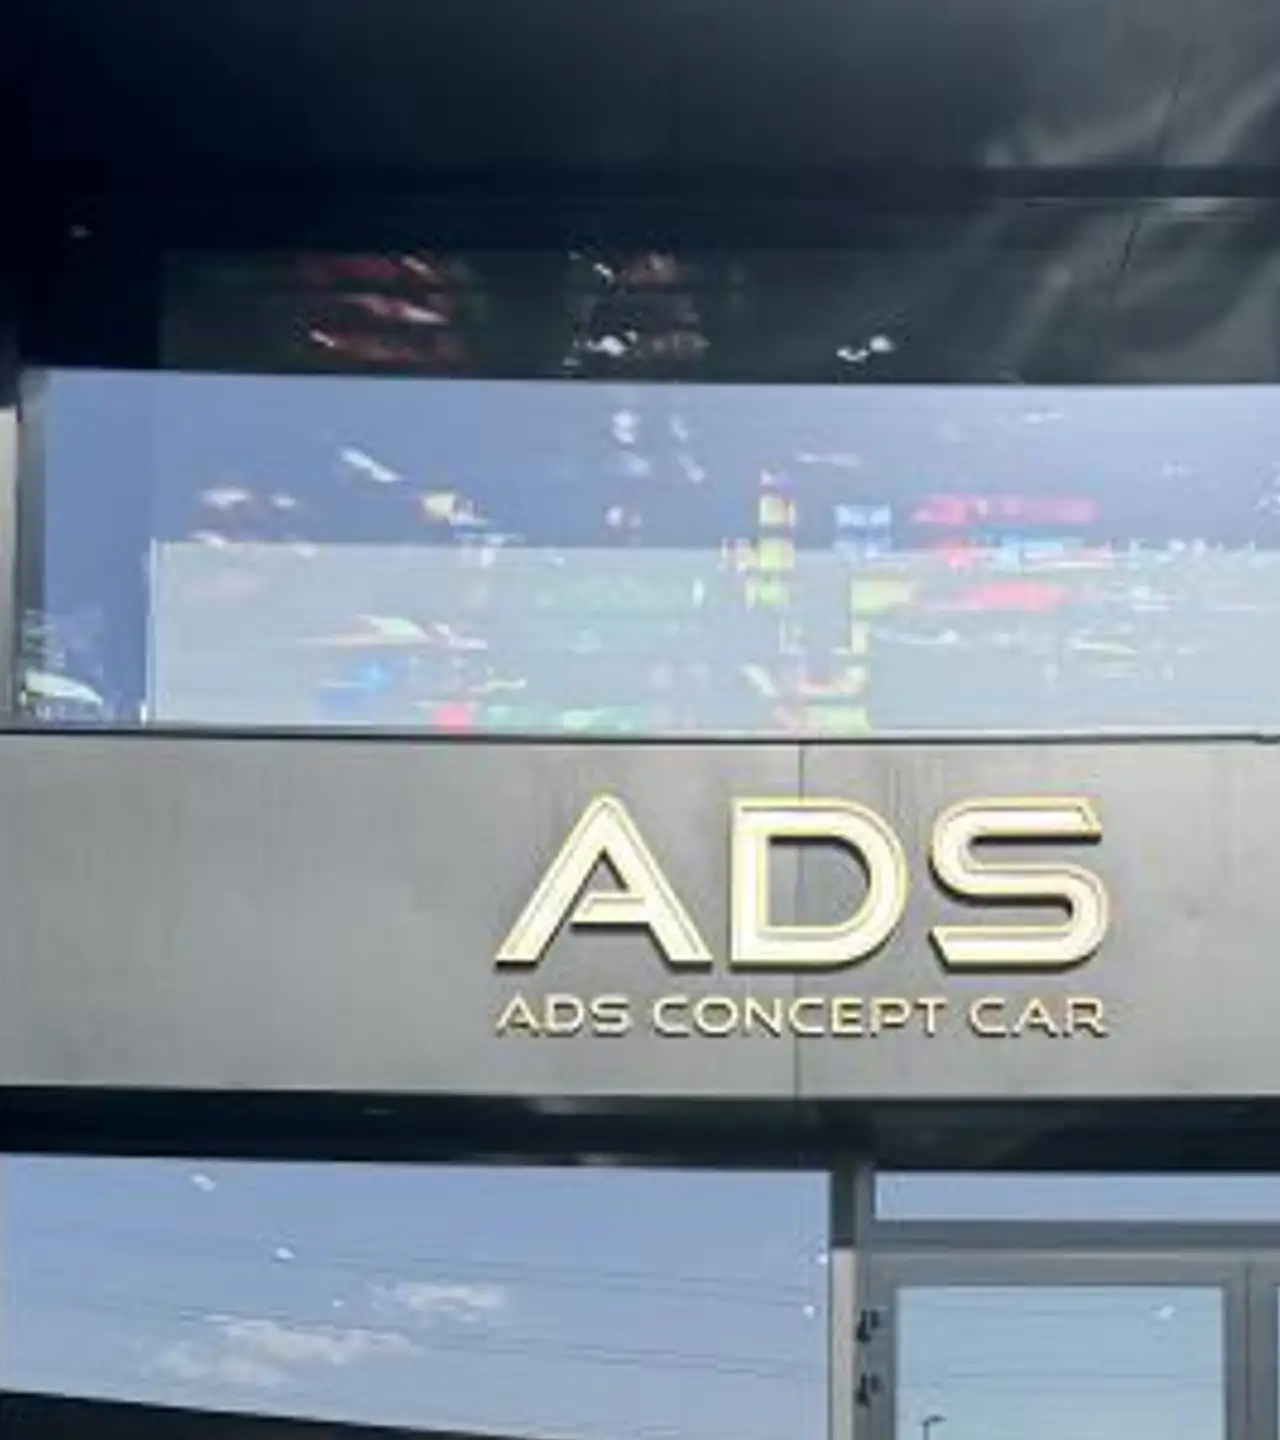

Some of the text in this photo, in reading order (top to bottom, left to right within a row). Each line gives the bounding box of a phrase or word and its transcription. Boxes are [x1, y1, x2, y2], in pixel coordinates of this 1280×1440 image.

[494, 793, 1109, 972] ADS
[494, 993, 1108, 1037] ADS CONCEPT CAR
